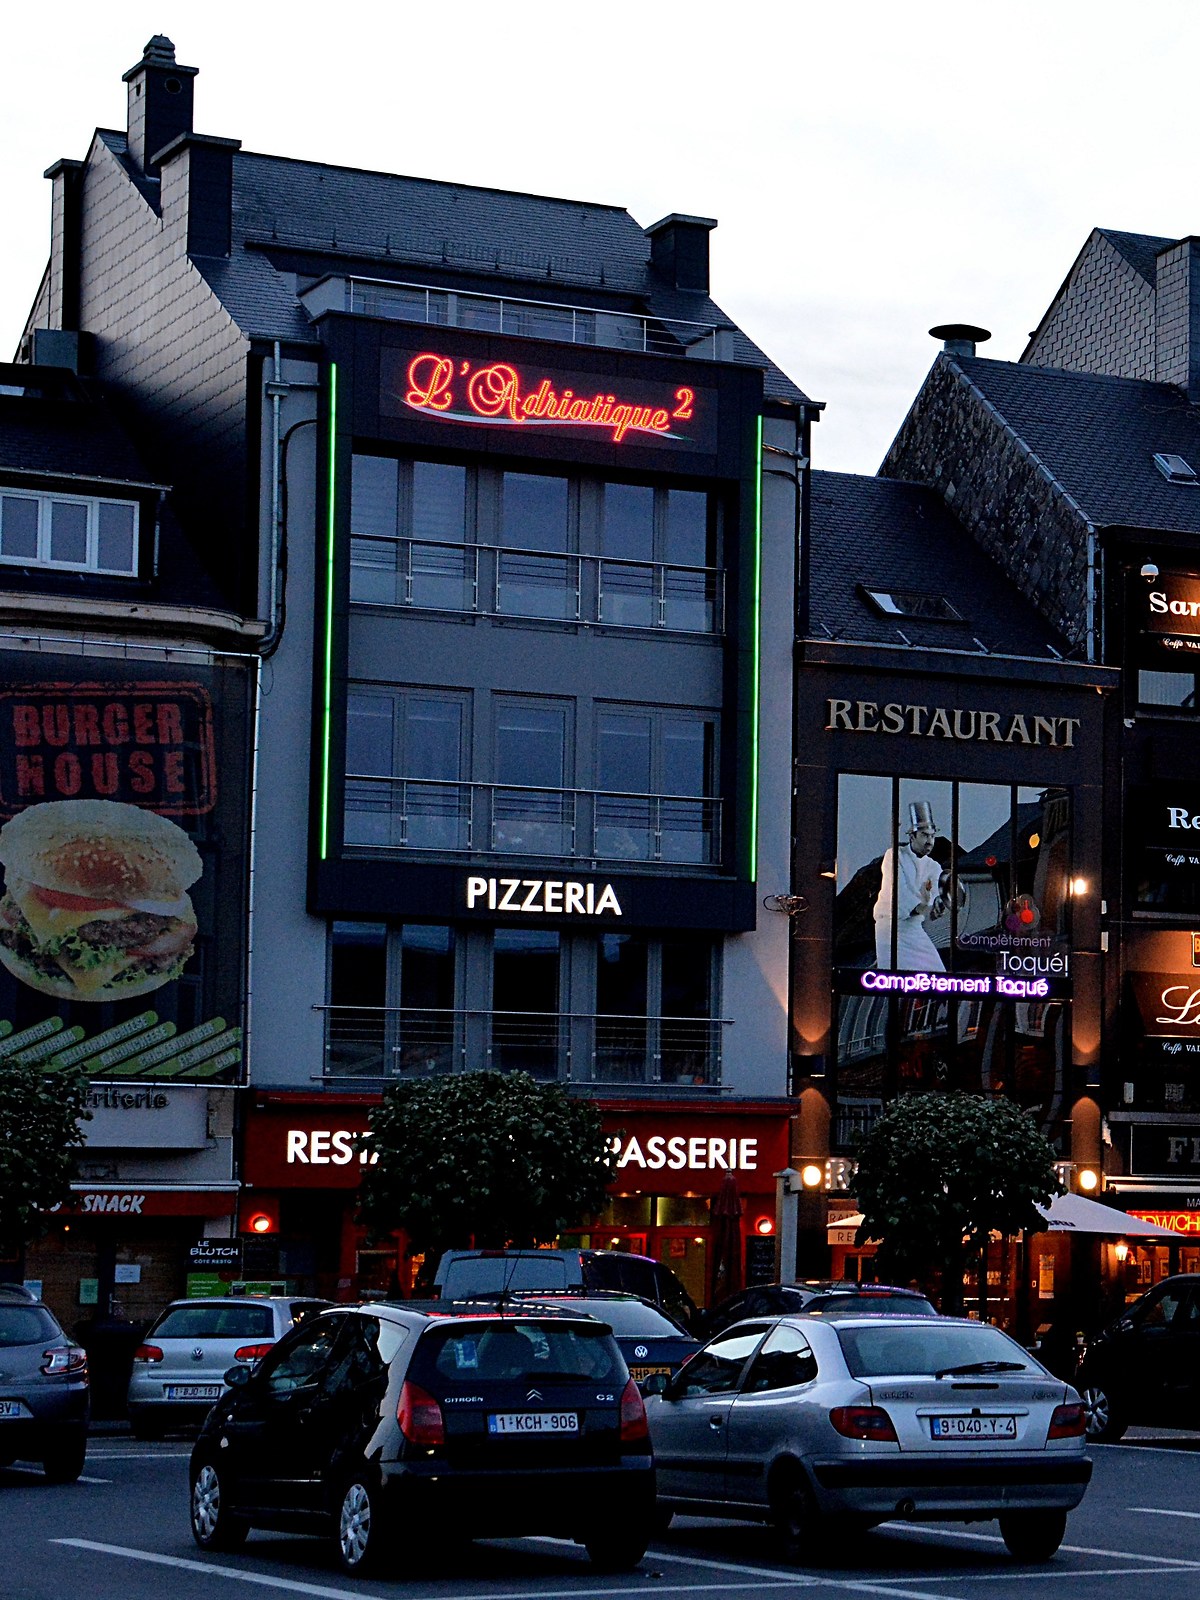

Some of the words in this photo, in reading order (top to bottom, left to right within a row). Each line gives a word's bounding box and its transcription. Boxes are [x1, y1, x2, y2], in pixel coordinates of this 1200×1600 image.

[406, 354, 670, 442] L'Adriatique
[13, 703, 183, 746] BURGER
[826, 699, 1080, 747] RESTAURANT
[16, 751, 185, 796] HOUSE
[467, 877, 622, 916] PIZZERIA
[958, 933, 1051, 949] Complètement
[1000, 951, 1068, 977] Toqué!
[861, 971, 991, 992] Complètement
[996, 976, 1048, 997] Toqué
[287, 1129, 379, 1165] RES
[81, 1194, 145, 1214] SNACK
[189, 1247, 238, 1256] BLUTCH
[596, 1393, 614, 1401] C2
